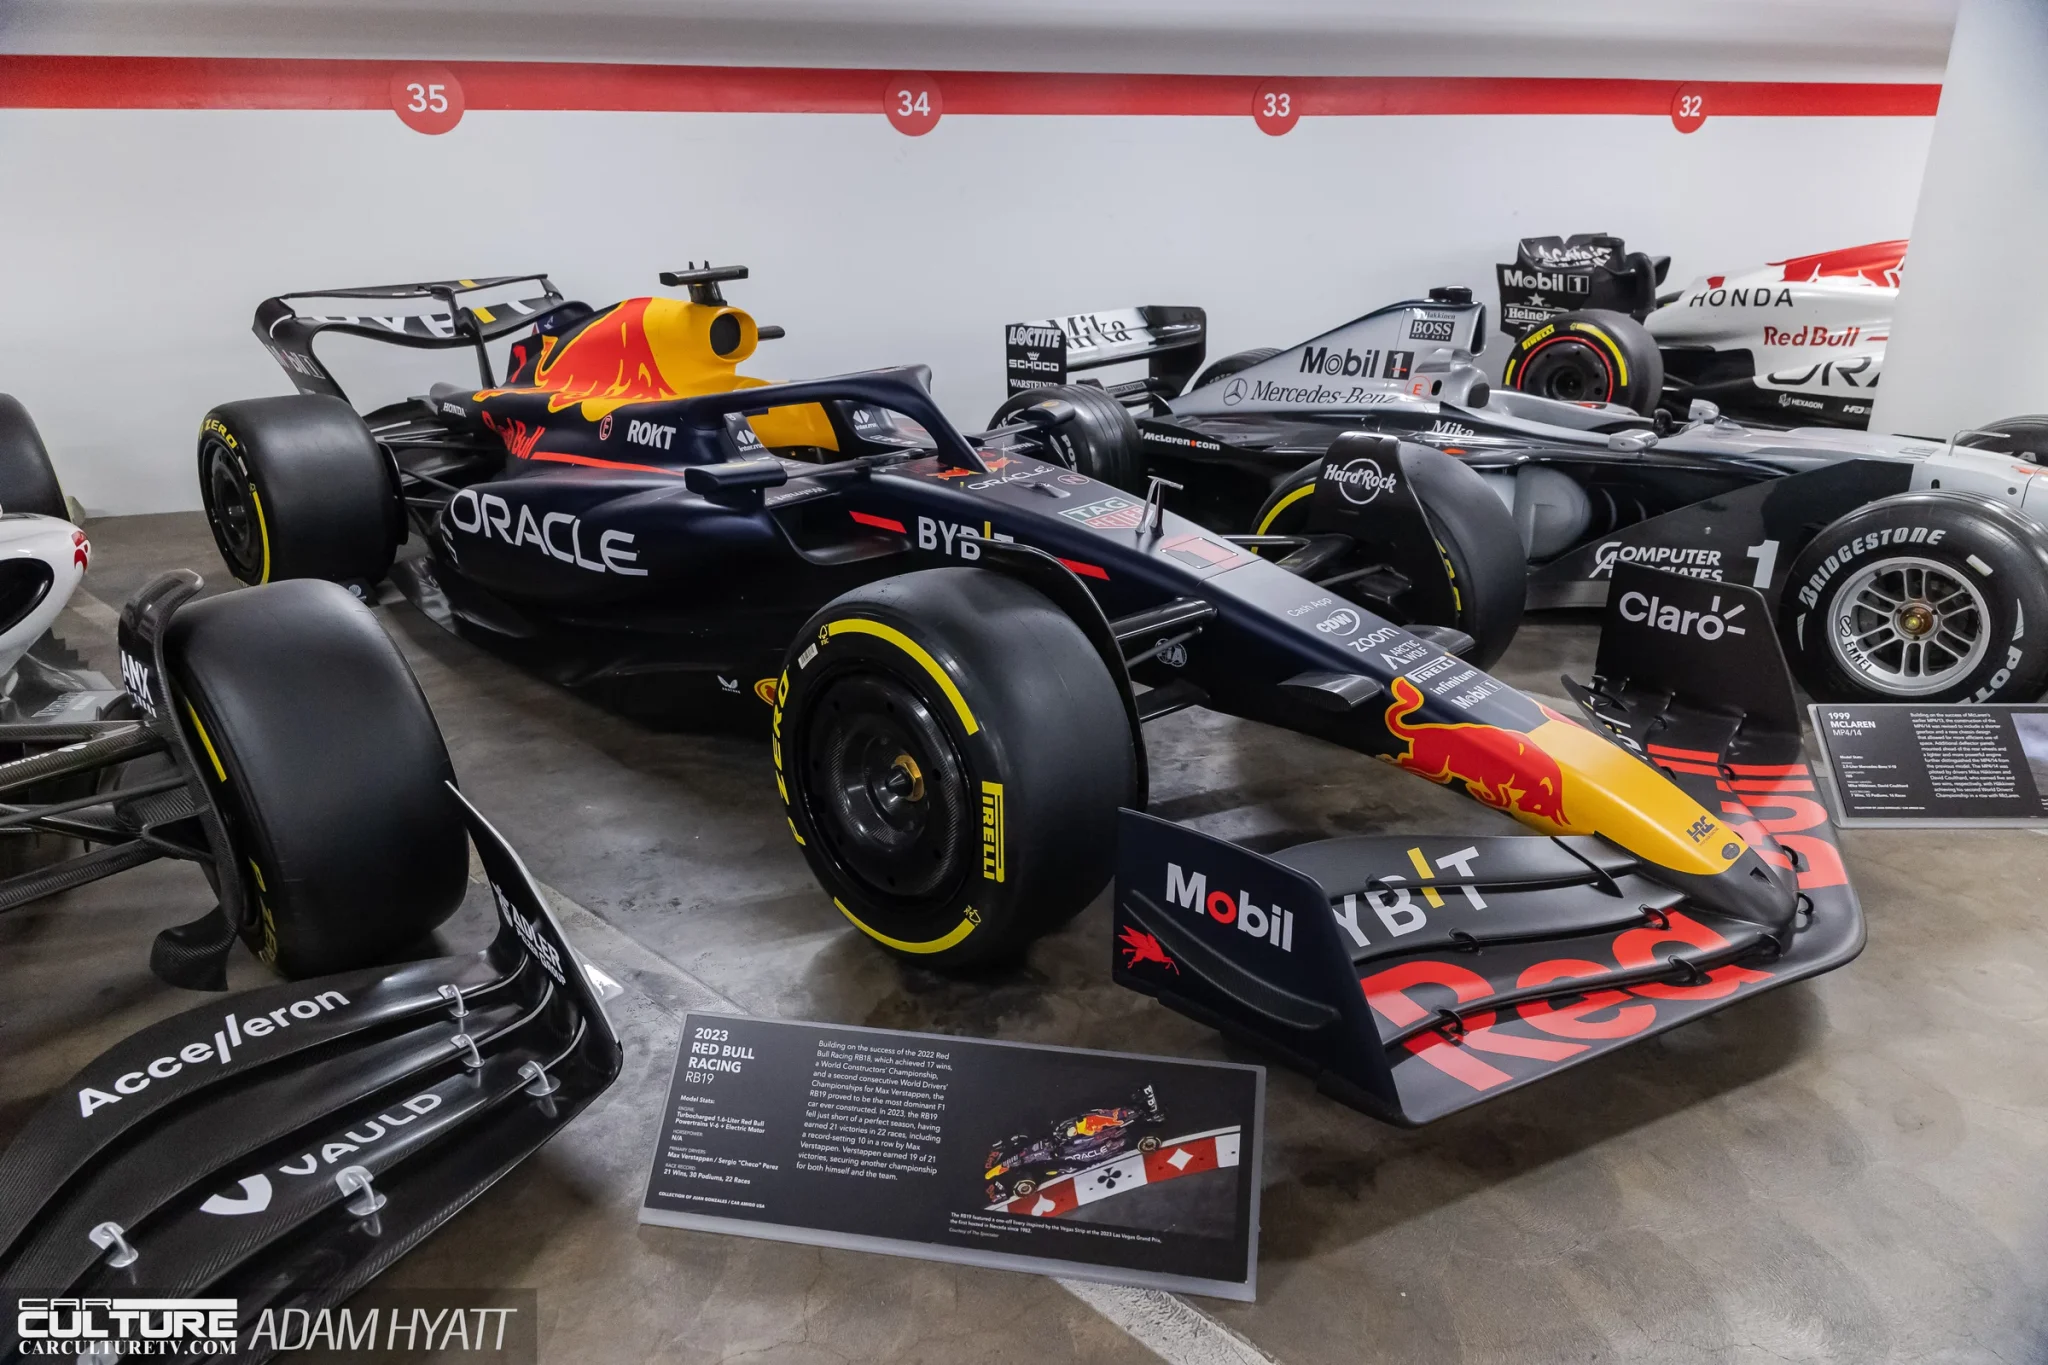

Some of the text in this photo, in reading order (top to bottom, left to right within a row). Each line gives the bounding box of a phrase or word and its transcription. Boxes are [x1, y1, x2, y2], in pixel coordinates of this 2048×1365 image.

[406, 83, 448, 114] 35
[897, 90, 930, 116] 34
[1262, 93, 1291, 116] 33
[1679, 96, 1702, 117] 32
[1504, 270, 1563, 292] Mobil
[1689, 288, 1793, 307] HONDA
[1008, 327, 1061, 348] LOCTITE
[1046, 315, 1132, 349] Mika
[1413, 321, 1451, 335] BOSS
[1764, 326, 1860, 346] Red Bull
[1009, 359, 1059, 372] SCHOCO
[1300, 346, 1380, 378] Mobil
[1251, 381, 1395, 404] Mercedes-Benz
[1413, 385, 1422, 395] E
[443, 402, 466, 418] HONDA
[1792, 399, 1823, 410] HEXAGON
[205, 419, 237, 449] ZERO
[627, 420, 676, 450] ROKT
[1432, 420, 1474, 437] Mika
[968, 465, 1054, 490] ORACLE
[1072, 499, 1128, 518] TAG
[451, 489, 648, 576] ORACLE
[1747, 539, 1780, 589] 1
[1799, 527, 1946, 609] BRIDGESTONE
[1287, 598, 1332, 616] Cash App
[1619, 592, 1724, 640] Claro
[1316, 613, 1352, 632] CDW
[1347, 628, 1400, 652] zoom
[1390, 640, 1420, 656] ARCTIC
[1403, 647, 1428, 661] WOLF
[1844, 641, 1872, 672] ENKEI
[1404, 656, 1456, 684] PIRELLI
[1430, 670, 1477, 695] infinitum
[1451, 686, 1492, 709] Mobil
[1828, 712, 1850, 720] 1999
[773, 669, 806, 845] P ZERO
[982, 780, 1004, 883] PIRELLI
[1166, 863, 1294, 952] Mobil
[511, 903, 563, 973] ADLER
[539, 952, 566, 986] GROUP
[1361, 907, 1773, 1091] Red
[695, 1028, 728, 1041] 2023
[819, 1040, 845, 1051] Building
[78, 990, 350, 1117] Accelleron
[692, 1042, 755, 1059] RED BULL
[831, 1051, 853, 1061] Racing
[855, 1054, 872, 1062] RB18,
[895, 1058, 925, 1066] achieved
[936, 1062, 952, 1070] wins,
[688, 1057, 742, 1073] RACING
[889, 1067, 938, 1079] Championship,
[685, 1071, 714, 1084] RB19
[859, 1077, 898, 1085] consecutive
[900, 1079, 921, 1087] World
[812, 1080, 863, 1093] Championships
[891, 1088, 931, 1099] Verstappen,
[904, 1100, 936, 1109] dominant
[280, 1092, 441, 1175] VAULD
